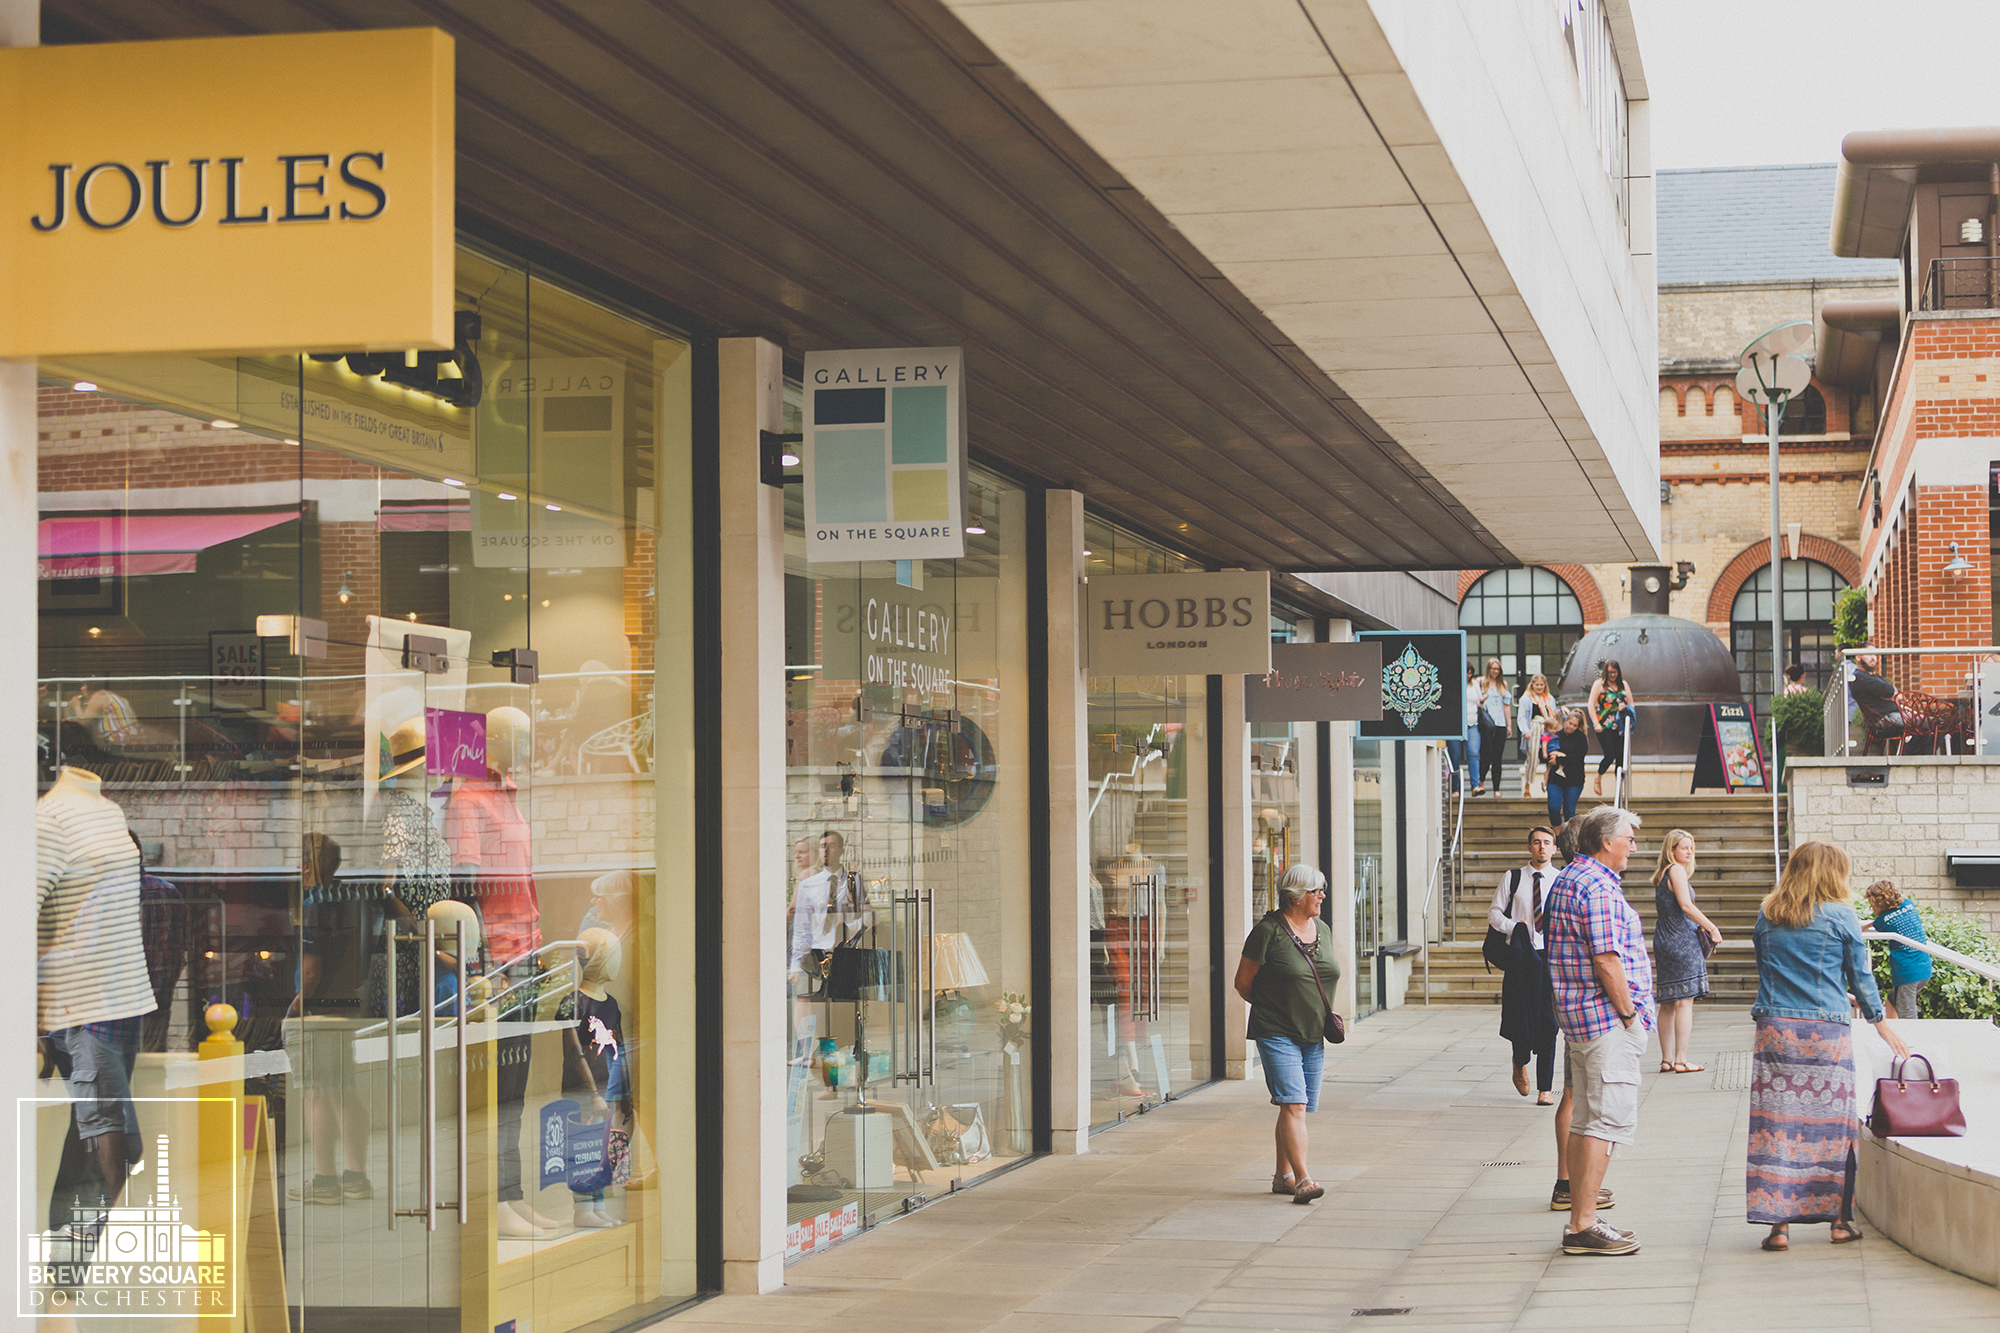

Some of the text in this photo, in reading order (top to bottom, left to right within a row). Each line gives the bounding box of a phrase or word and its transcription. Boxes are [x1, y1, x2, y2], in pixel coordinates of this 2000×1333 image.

[31, 152, 388, 232] JOULES
[814, 365, 948, 384] GALLERY
[281, 392, 437, 450] ESTALISHED IN THE FIELDS OF GREAT BRITAIN
[816, 527, 951, 541] ON THE SQUARE
[1103, 597, 1253, 630] HOBBS
[867, 598, 950, 655] GALLERY
[1147, 640, 1208, 649] LONDON
[217, 645, 257, 664] SALE
[867, 654, 951, 695] ON THE SQUARE
[1720, 705, 1745, 717] Zizzi
[843, 1209, 857, 1227] SALE
